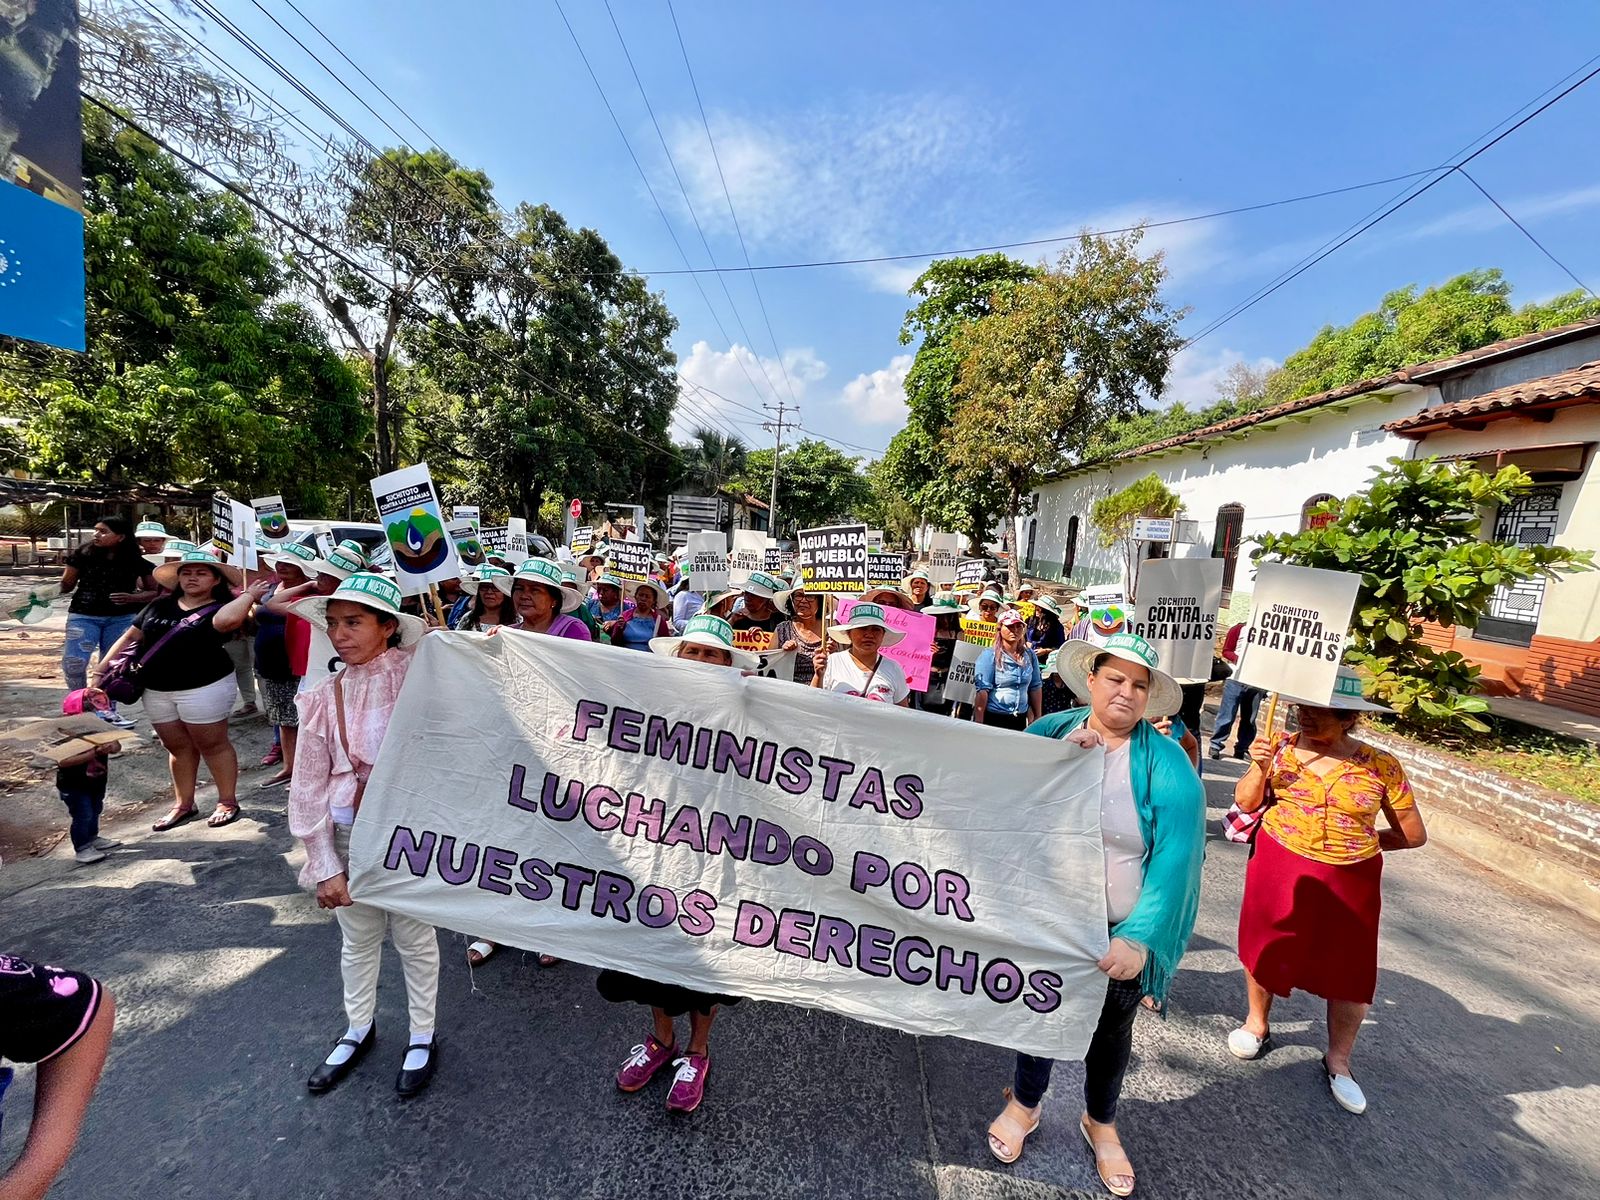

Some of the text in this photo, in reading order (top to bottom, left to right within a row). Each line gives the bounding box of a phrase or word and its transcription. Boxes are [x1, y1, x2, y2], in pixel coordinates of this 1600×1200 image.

[380, 501, 398, 511] CONTRA
[408, 491, 430, 503] GRANJAS
[386, 487, 419, 502] SUCHITOTO
[481, 530, 499, 539] AGUA
[492, 536, 507, 544] PUE
[801, 532, 866, 550] AGUA PARA
[610, 542, 650, 555] AGUA PARA
[618, 553, 648, 564] PUEBLO
[694, 556, 719, 564] CONTRA
[737, 553, 758, 562] CONTRA
[802, 548, 866, 564] EL PUEBLO
[933, 552, 951, 560] CONTRA
[618, 563, 634, 572] PARA
[636, 565, 647, 574] LA
[690, 564, 726, 572] GRANJAS
[732, 560, 763, 572] GRANJAS
[802, 565, 865, 579] NO PARA LA
[869, 564, 902, 572] PUEBLO
[352, 578, 367, 589] POR
[367, 579, 394, 600] NUESTROS
[804, 581, 864, 591] AGROINDUSTRIA
[1158, 597, 1196, 606] SUCHITOTO
[1148, 606, 1215, 623] CONTRA LAS
[1272, 603, 1319, 620] SUCHITOTO
[966, 622, 978, 630] LAS
[1136, 623, 1214, 640] GRANJAS
[1261, 612, 1341, 643] CONTRA LAS
[1134, 640, 1147, 653] POR
[1247, 627, 1339, 662] GRANJAS
[572, 699, 924, 819] FEMINISTAS
[508, 764, 975, 922] LUCHANDO POR
[384, 825, 1063, 1013] NUESTROS DERECHOS
